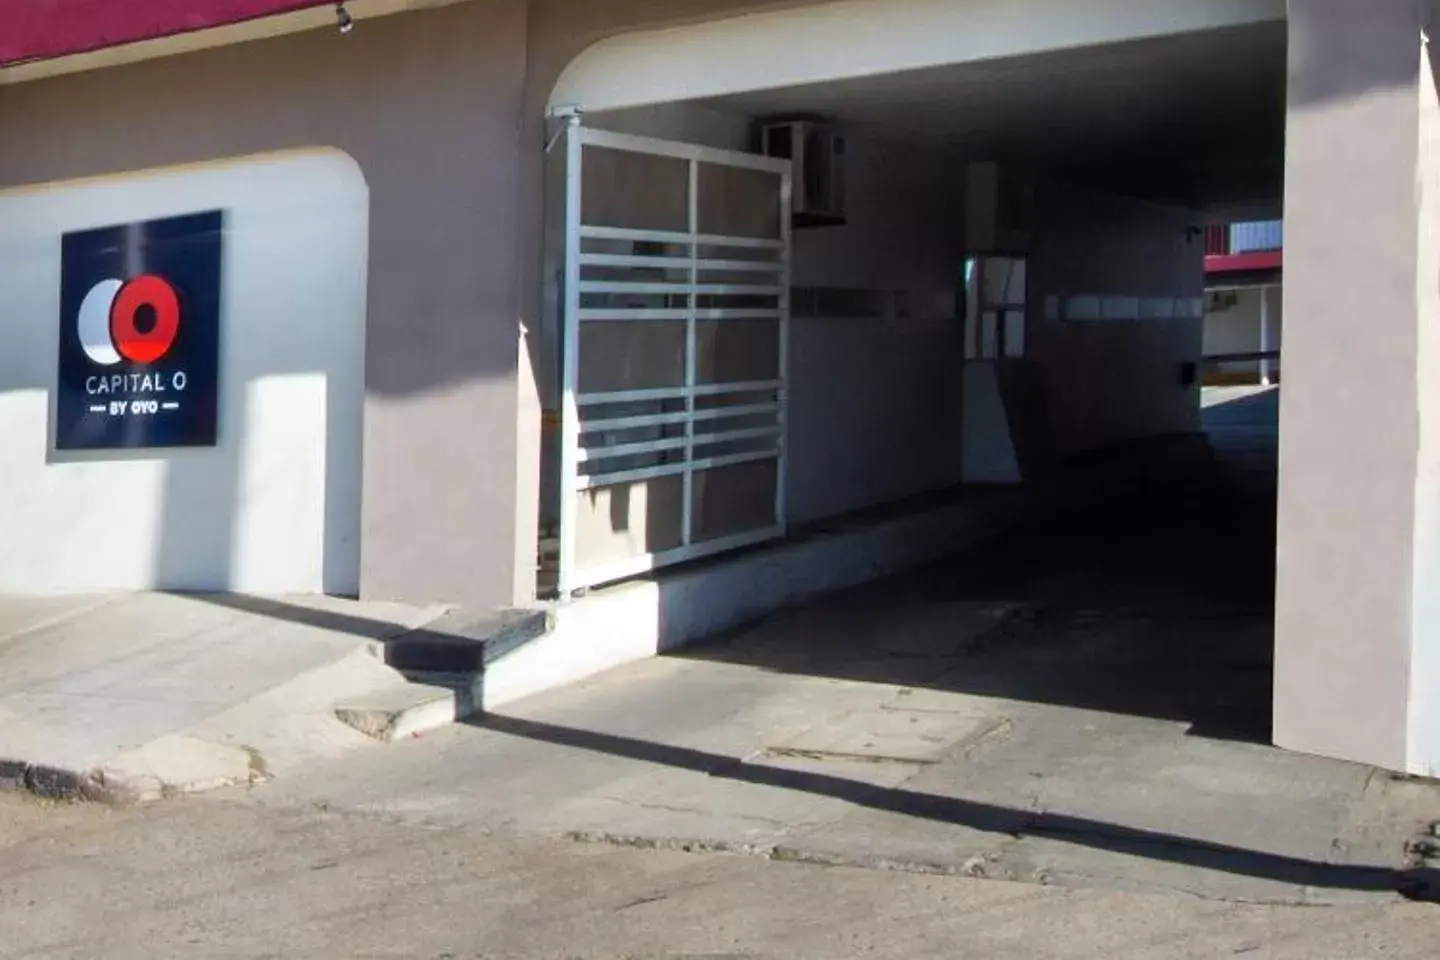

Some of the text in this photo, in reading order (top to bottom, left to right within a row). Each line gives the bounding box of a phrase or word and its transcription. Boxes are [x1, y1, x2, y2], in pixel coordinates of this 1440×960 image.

[86, 371, 186, 394] CAPITAL O
[109, 400, 158, 415] BY OYO
